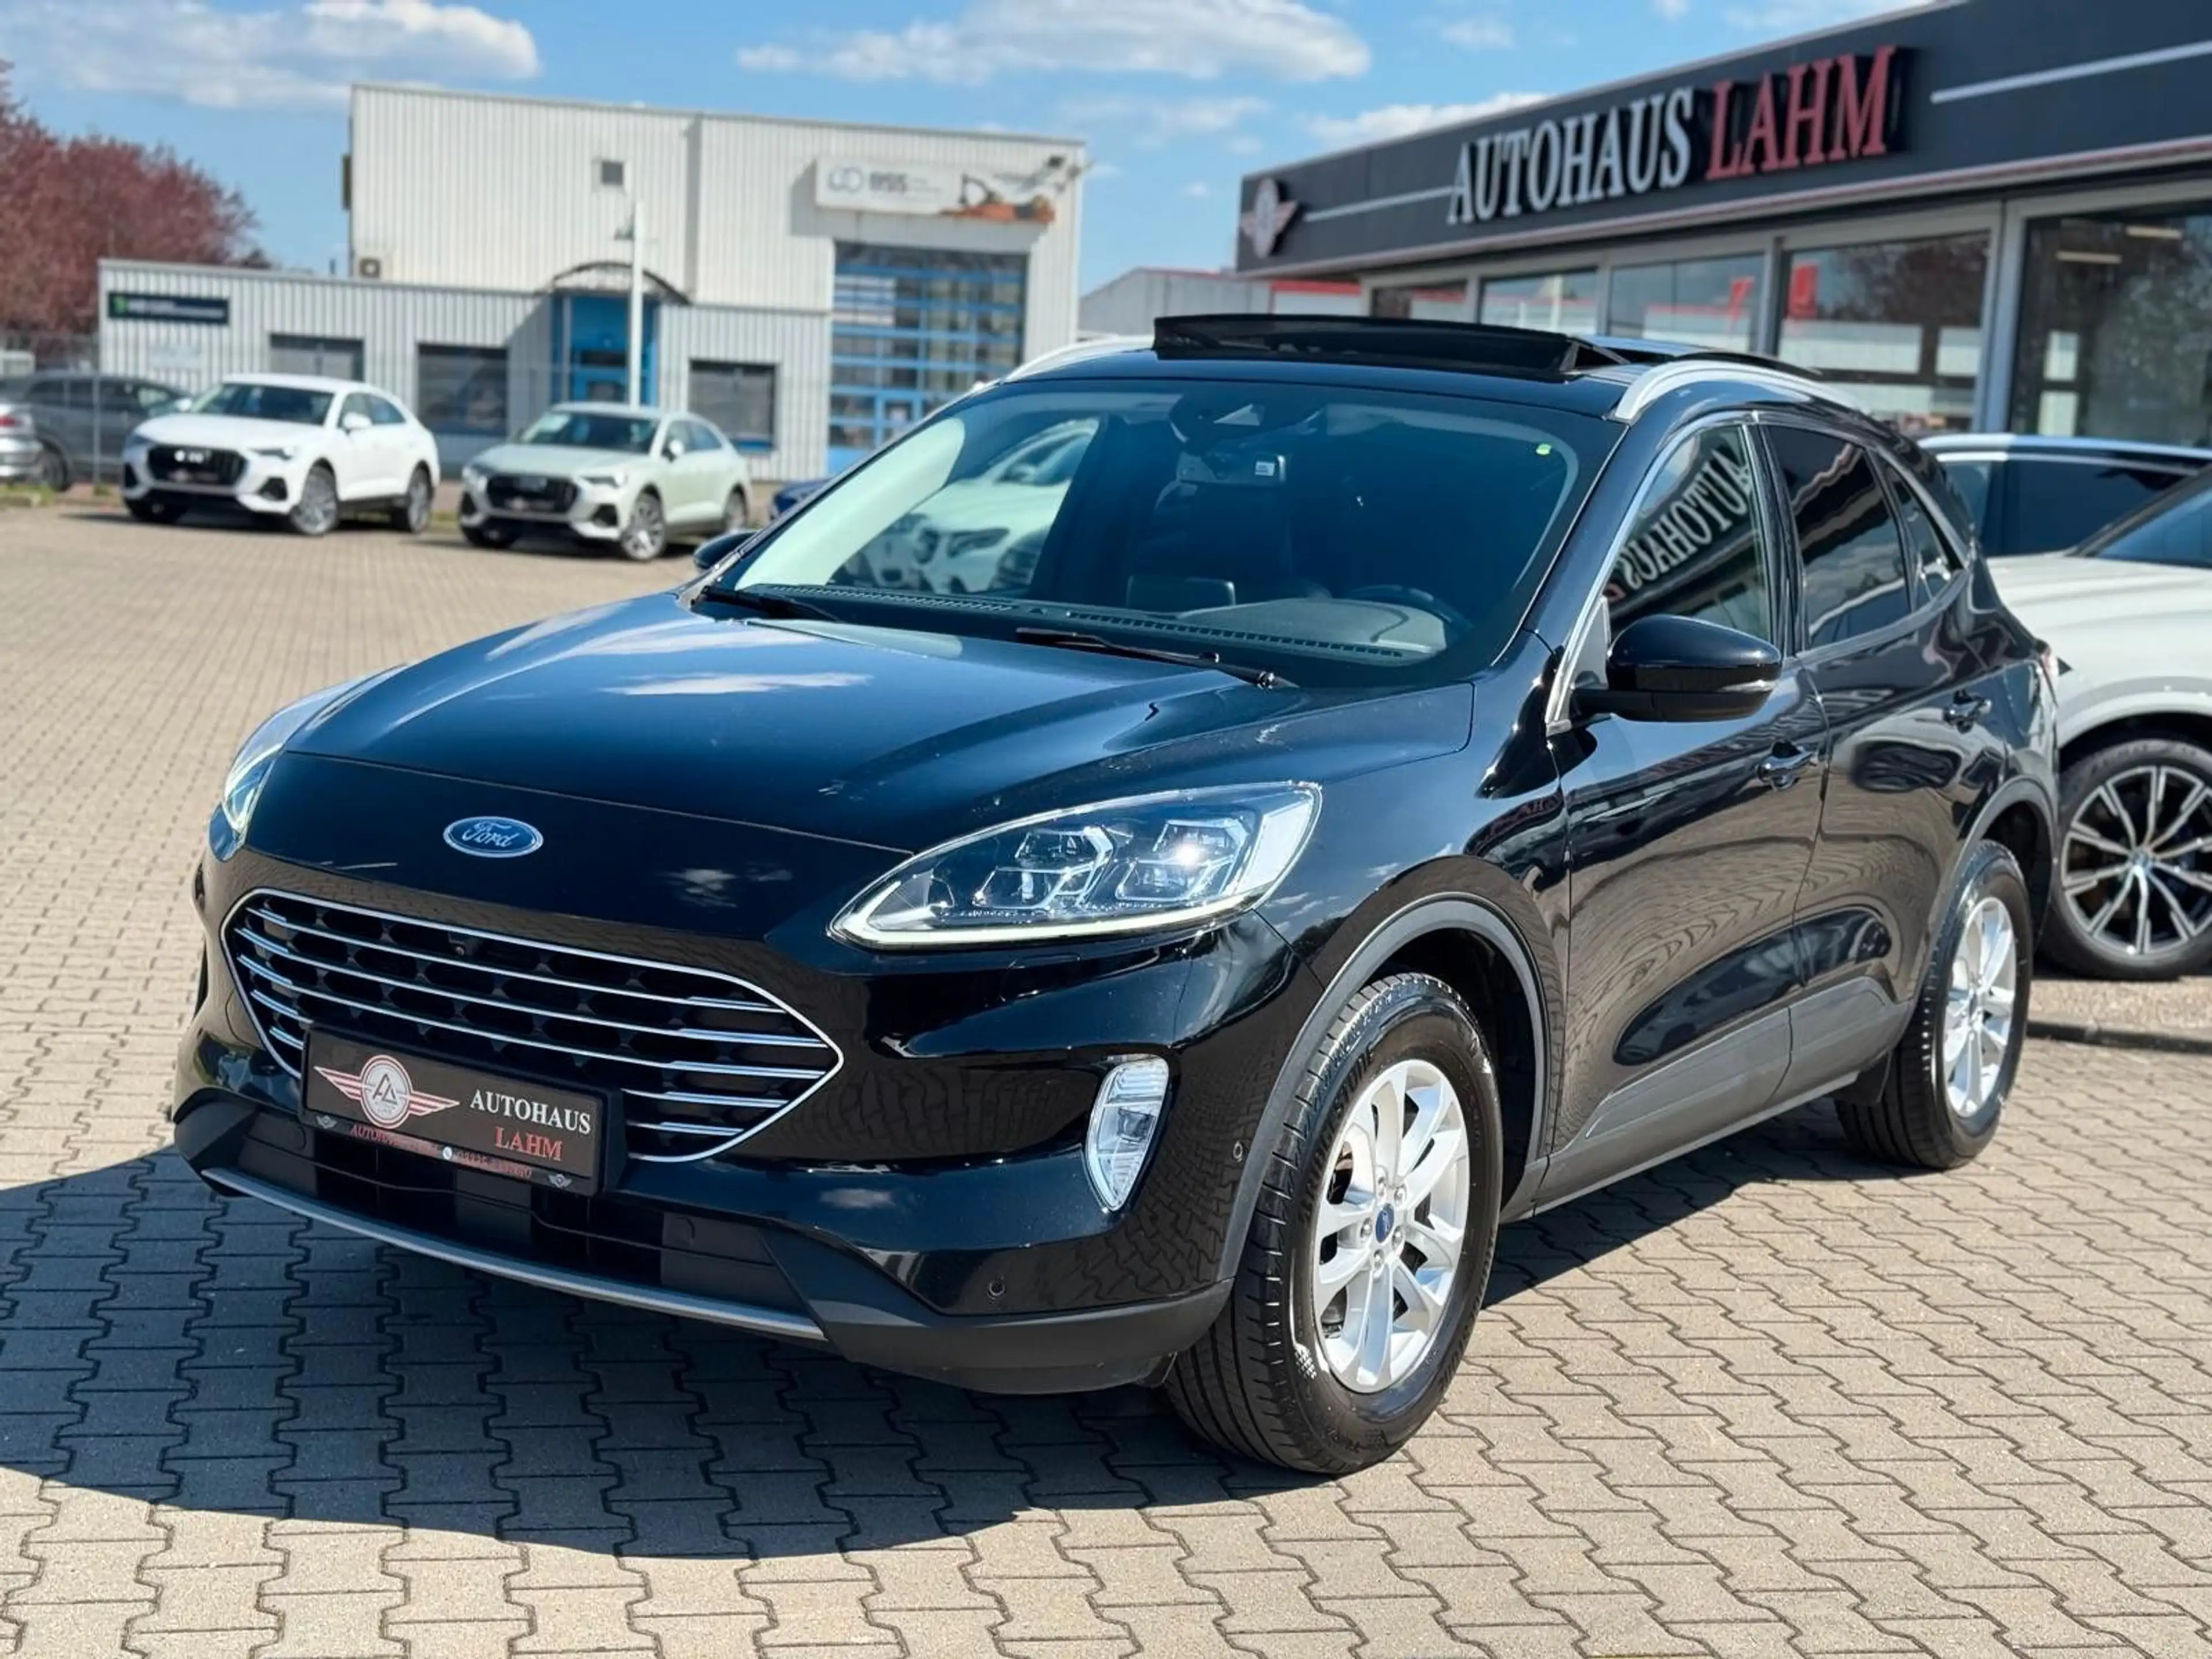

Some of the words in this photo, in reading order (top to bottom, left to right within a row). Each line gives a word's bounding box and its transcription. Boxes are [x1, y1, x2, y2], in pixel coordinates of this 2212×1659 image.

[1446, 86, 1694, 225] AUTOHAUS
[1706, 44, 1897, 181] LAHM
[461, 821, 520, 847] Ford
[469, 1089, 591, 1135] AUTOHAUS
[494, 1126, 563, 1162] LAHM
